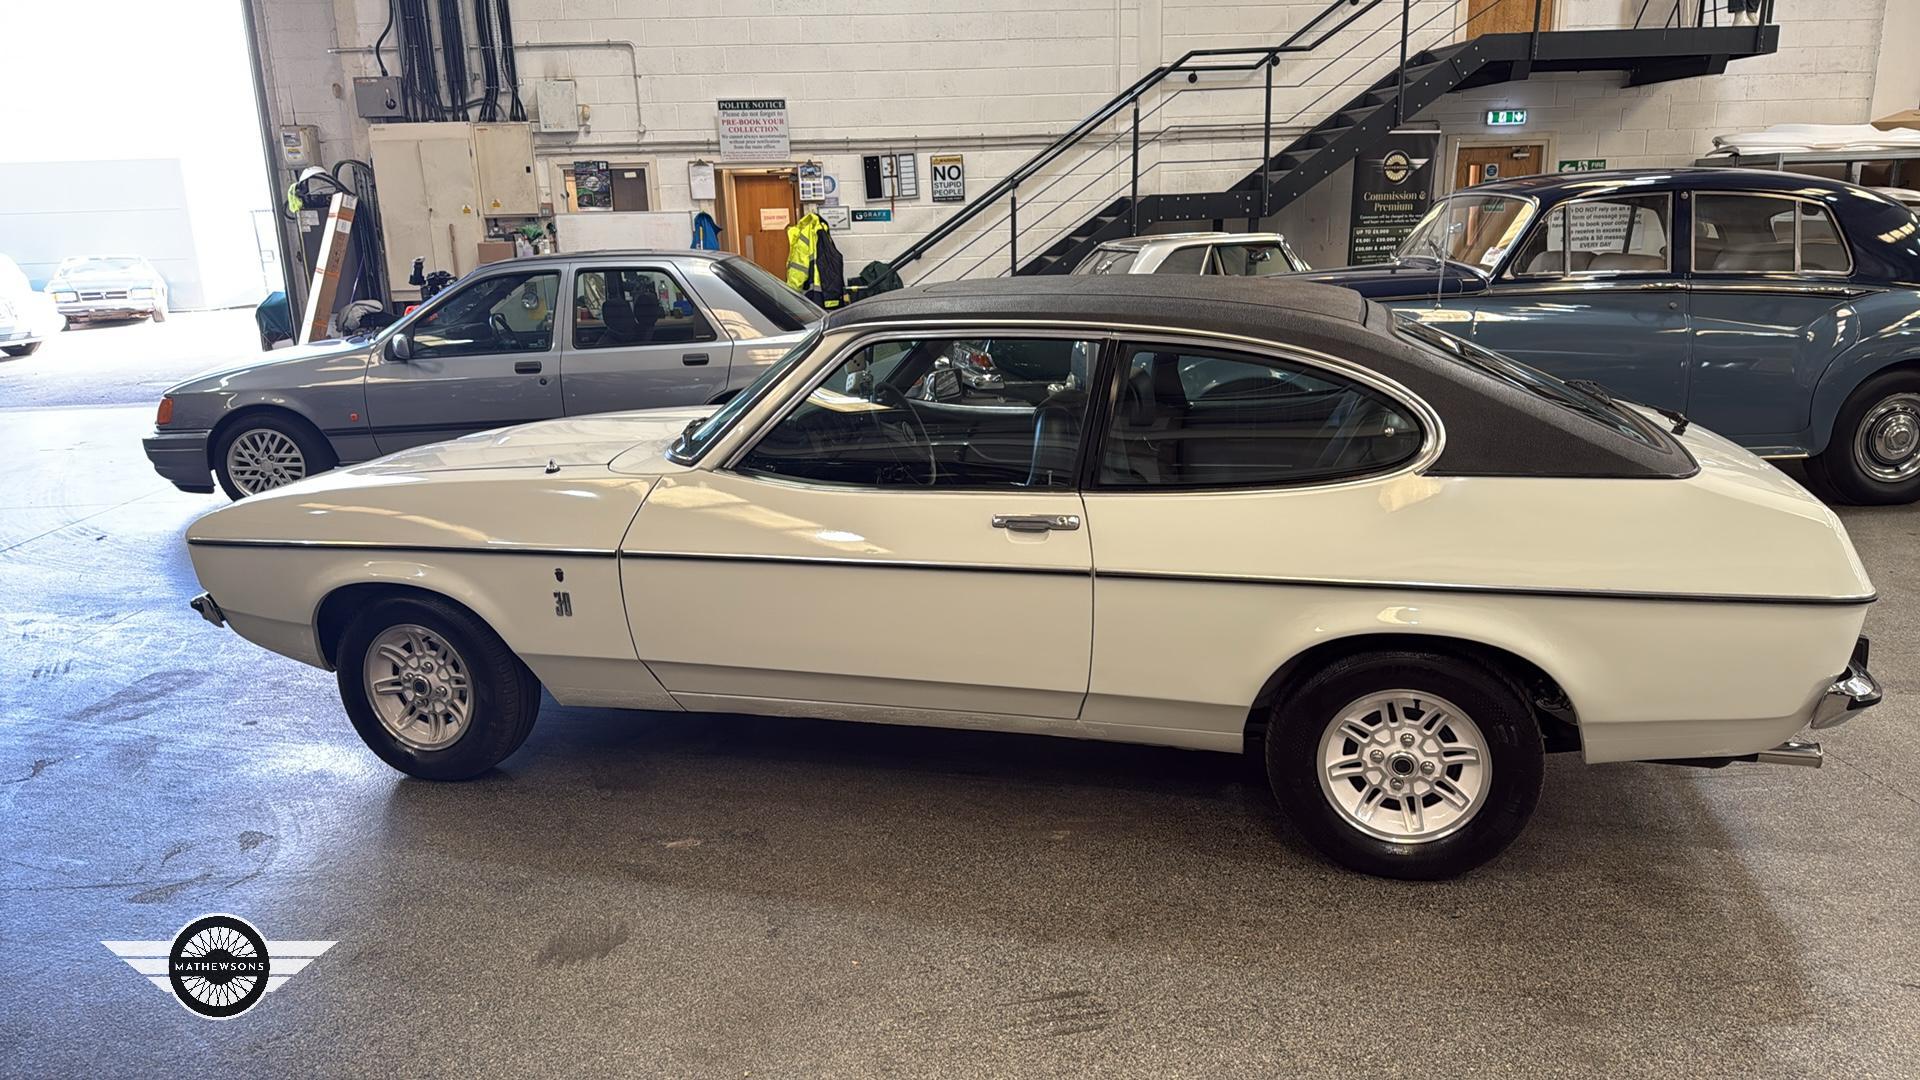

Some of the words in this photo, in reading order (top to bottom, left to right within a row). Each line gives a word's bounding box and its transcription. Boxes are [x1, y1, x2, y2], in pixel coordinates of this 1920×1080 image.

[720, 101, 750, 109] POLITE
[934, 165, 961, 181] NO
[934, 181, 962, 189] STUPID
[1363, 190, 1417, 201] Commission
[1419, 190, 1426, 200] &
[1374, 201, 1413, 211] Premium
